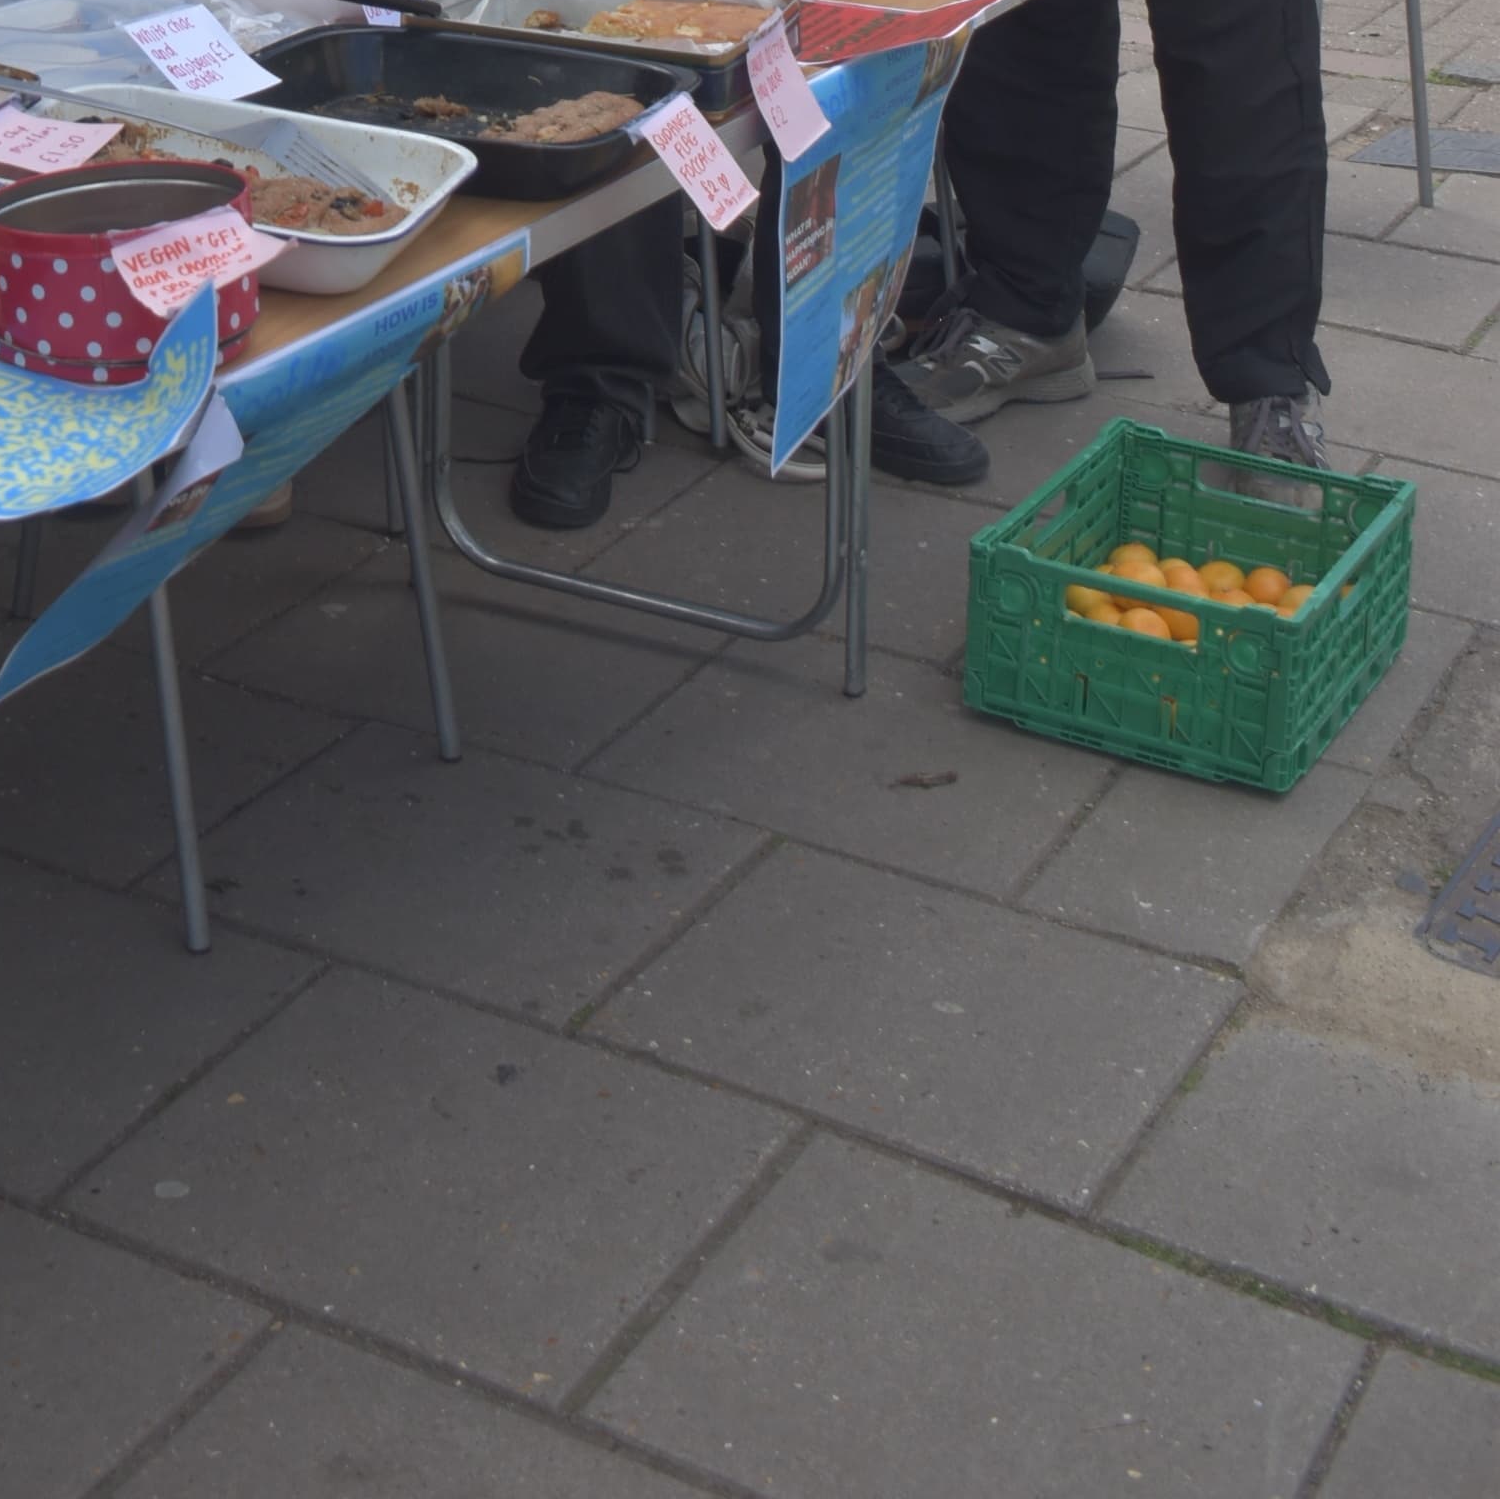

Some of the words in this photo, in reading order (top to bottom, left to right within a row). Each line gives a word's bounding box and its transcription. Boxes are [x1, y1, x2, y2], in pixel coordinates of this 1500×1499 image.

[132, 24, 168, 46] White
[150, 42, 179, 61] and
[208, 39, 235, 62] £1
[652, 107, 696, 152] SUDANESE
[769, 104, 789, 130] £2
[38, 134, 86, 165] £1.50
[674, 131, 699, 160] FLAG
[699, 178, 720, 202] £2
[122, 235, 191, 273] VEGAN
[207, 226, 242, 249] GF!
[373, 299, 419, 338] HOW
[421, 289, 440, 314] IS
